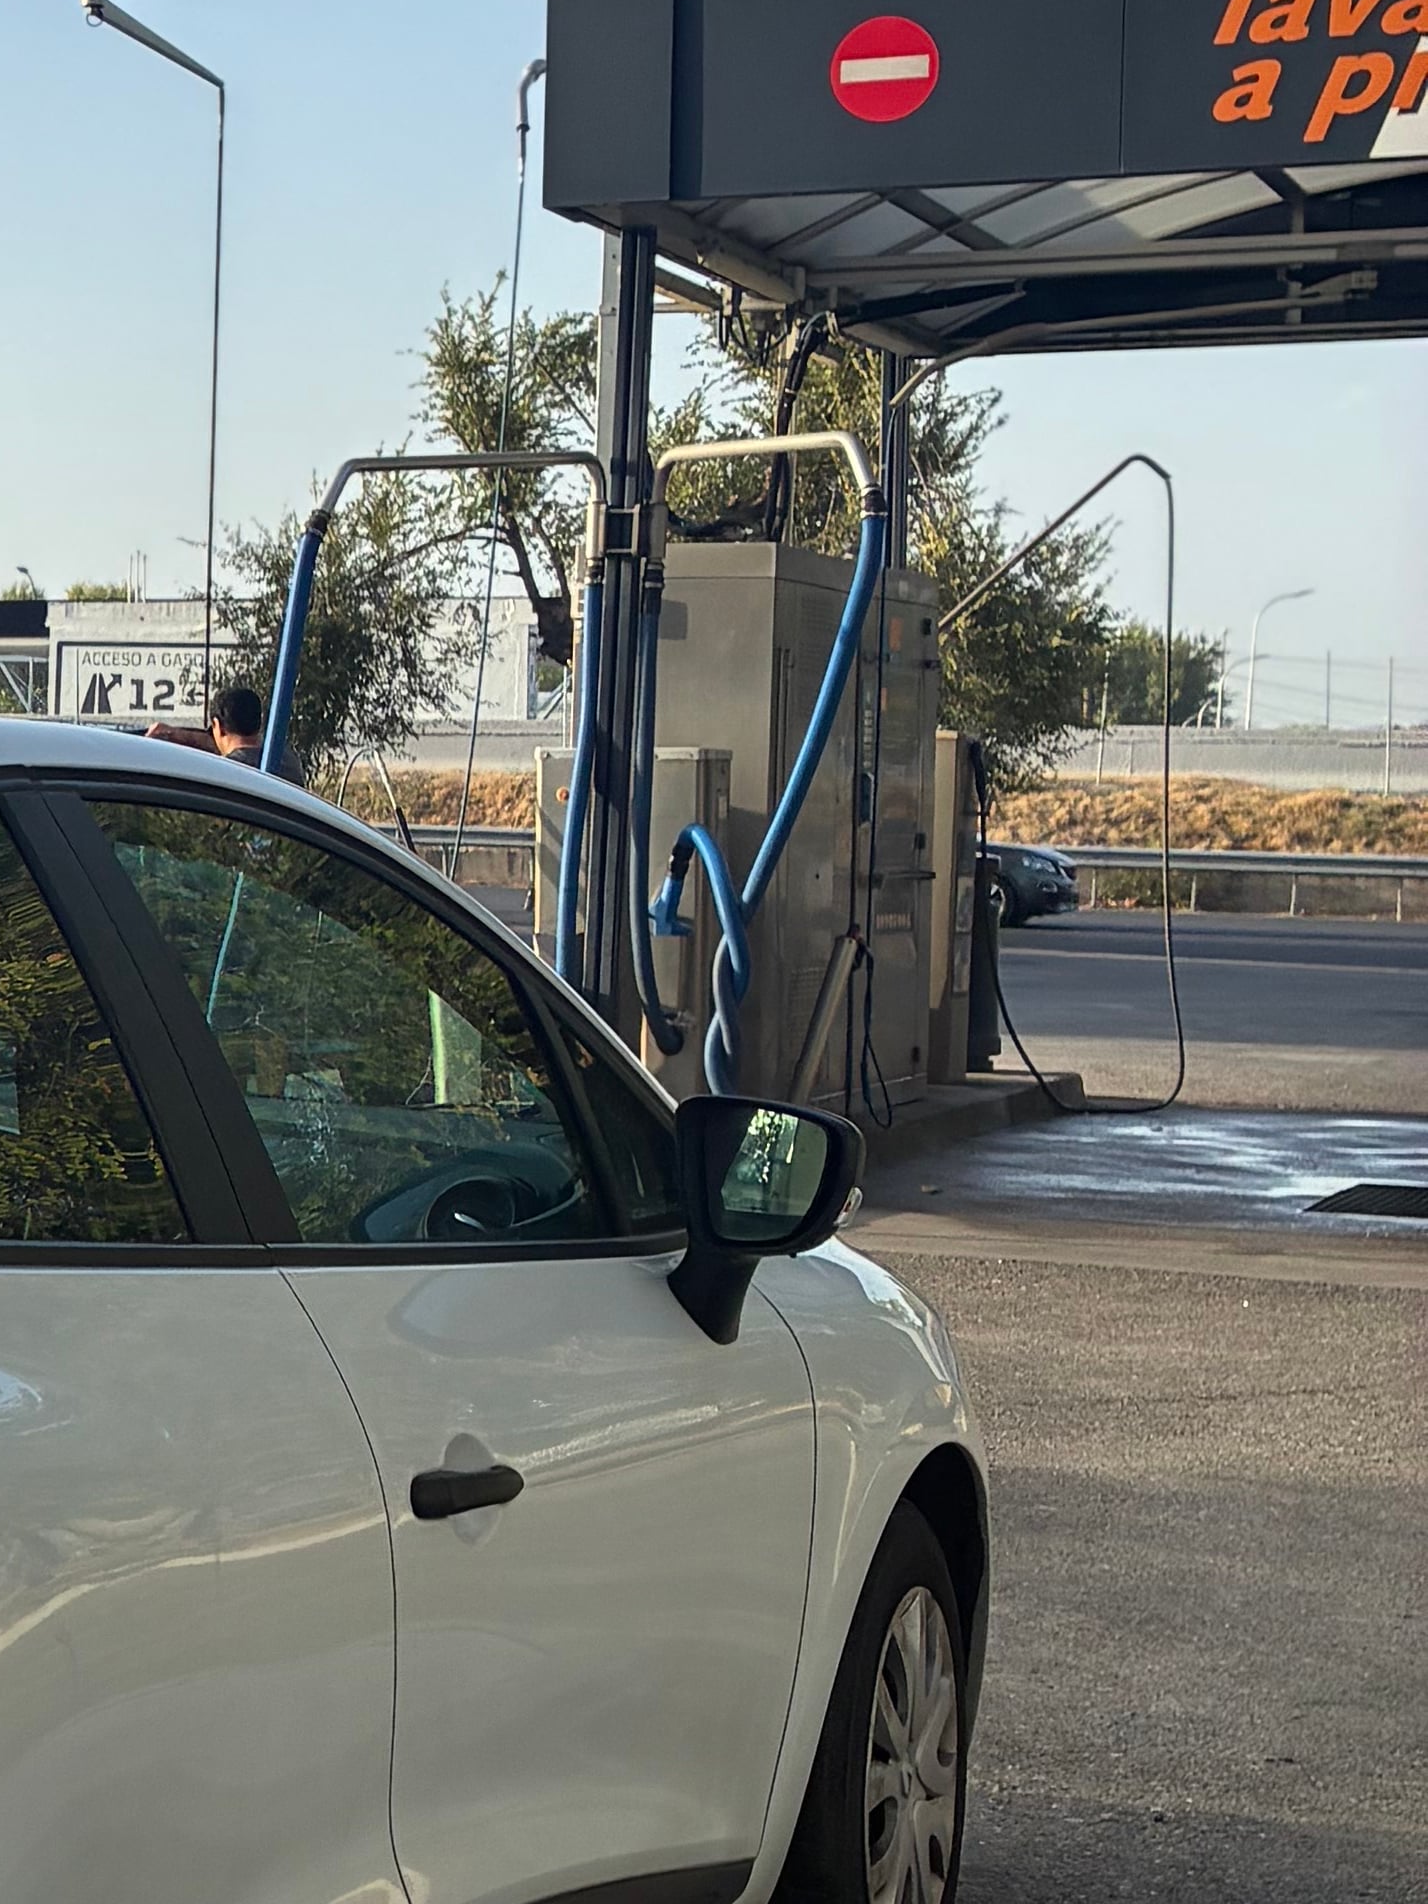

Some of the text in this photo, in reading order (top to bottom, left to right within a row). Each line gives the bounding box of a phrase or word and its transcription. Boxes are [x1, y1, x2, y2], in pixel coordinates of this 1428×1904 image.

[1212, 59, 1282, 123] a
[81, 651, 142, 667] ACCESO
[146, 652, 157, 667] A
